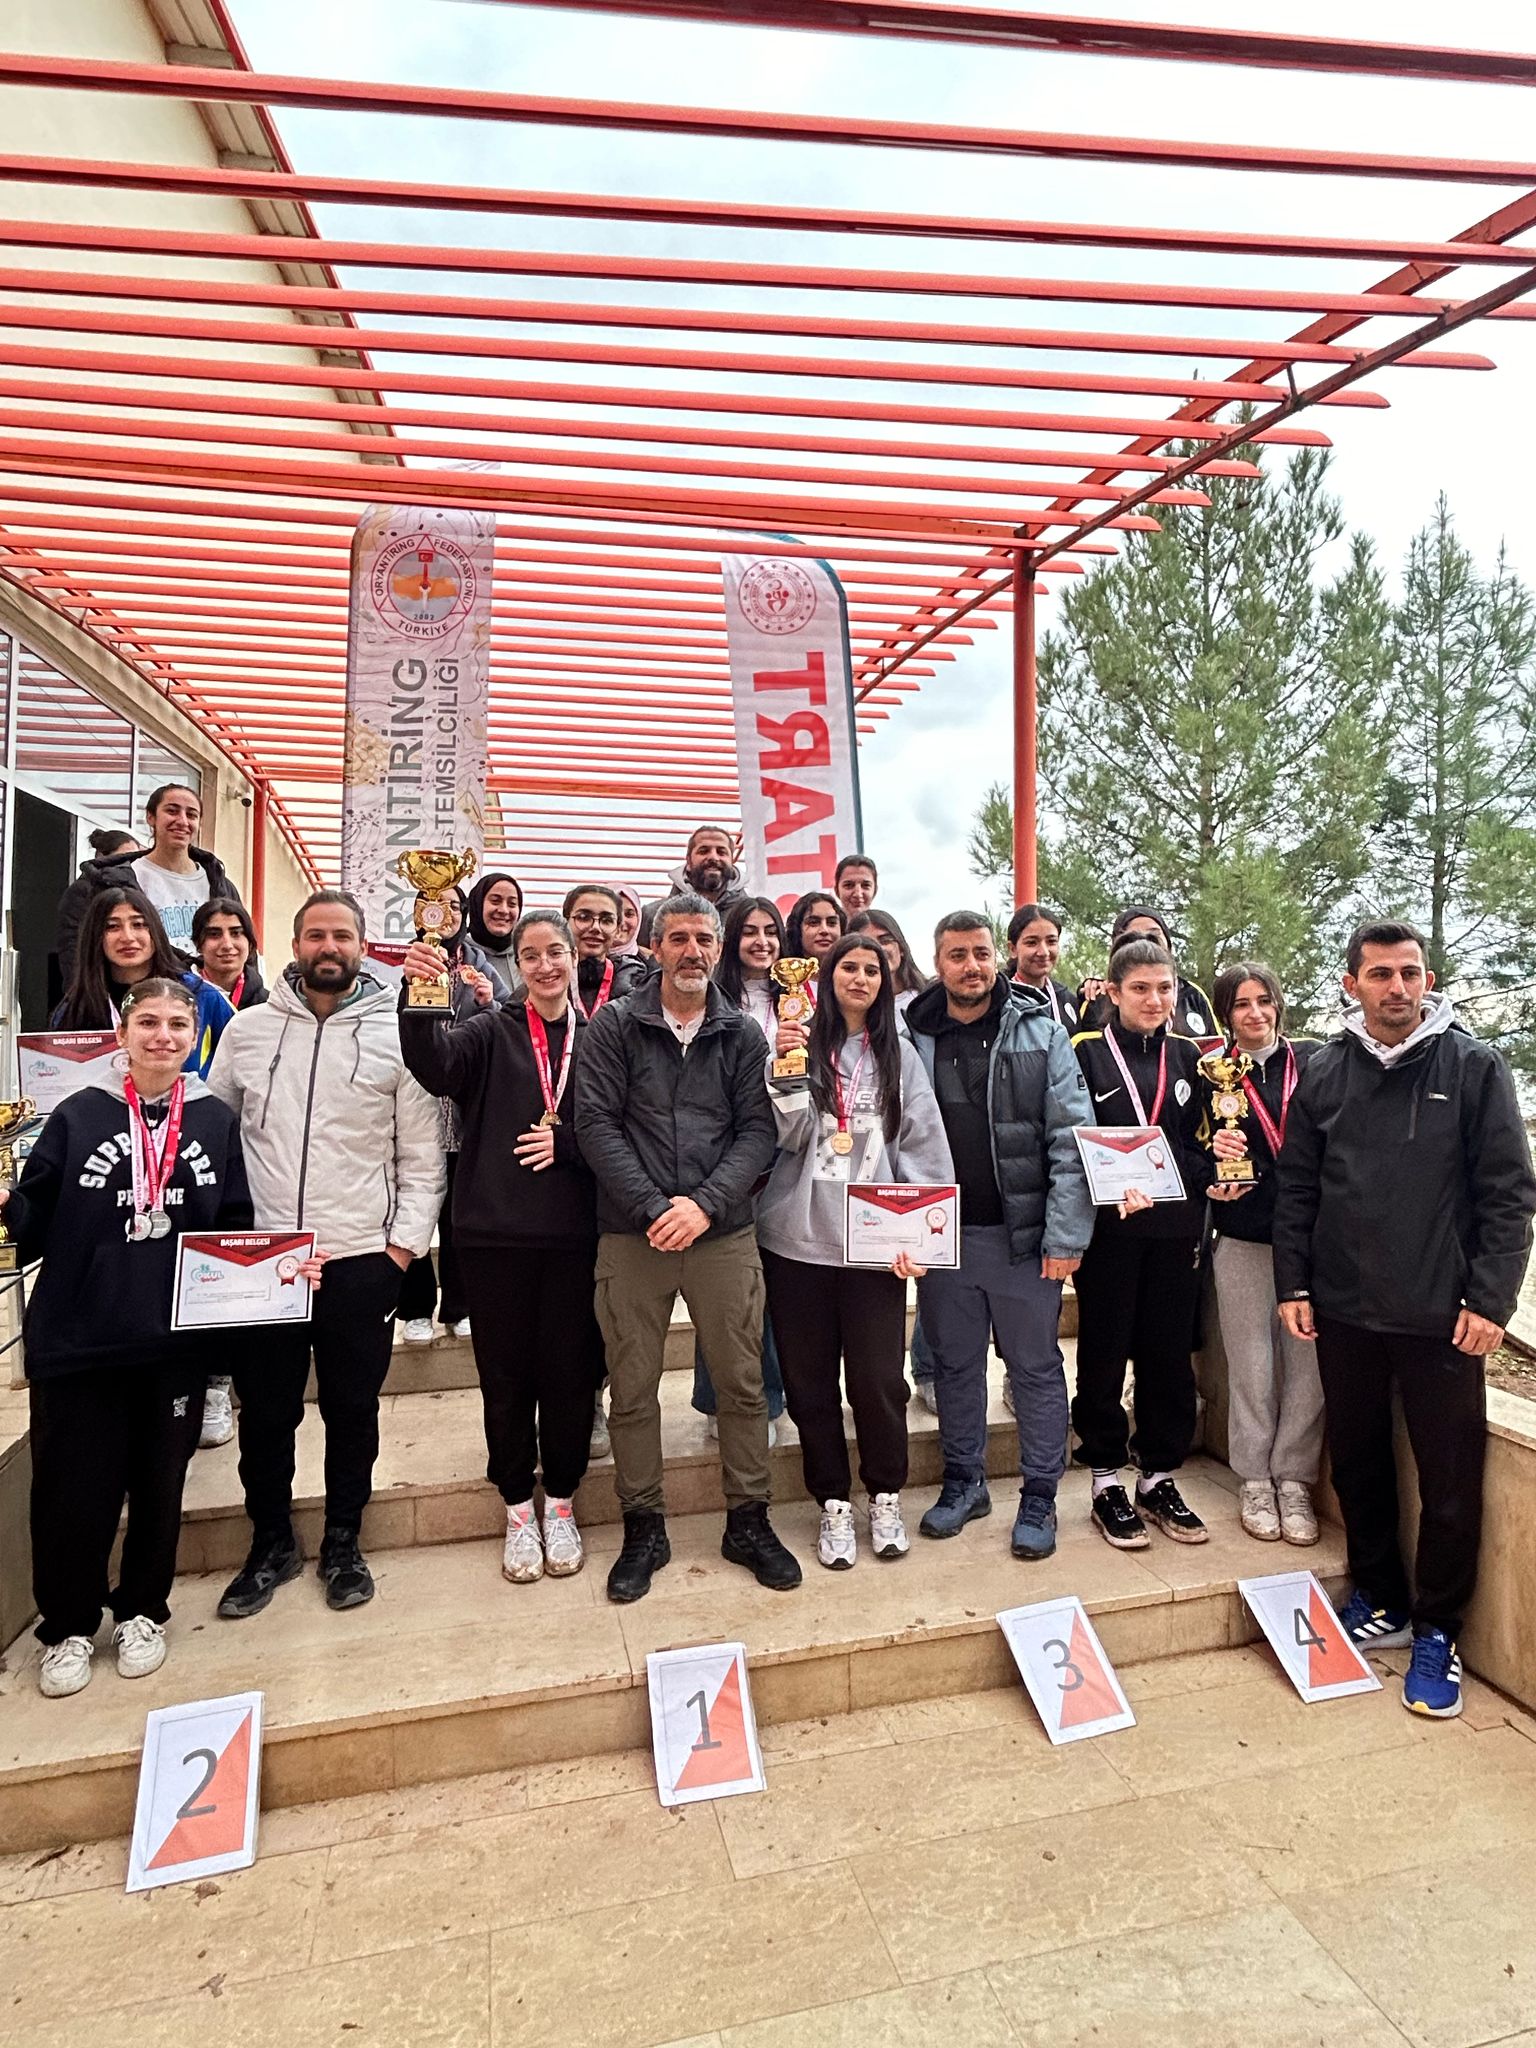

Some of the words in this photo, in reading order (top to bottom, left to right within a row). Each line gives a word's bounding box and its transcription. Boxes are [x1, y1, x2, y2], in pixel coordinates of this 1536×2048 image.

[375, 538, 415, 597] ORYANTİRİNG
[434, 538, 473, 604] FEDERASYONU
[398, 620, 449, 636] TÜRKİYE
[379, 658, 427, 939] RYNTİRİNG
[1293, 1607, 1327, 1655] 4
[1042, 1638, 1085, 1691] 3
[686, 1690, 722, 1751] 1
[176, 1748, 218, 1819] 2
